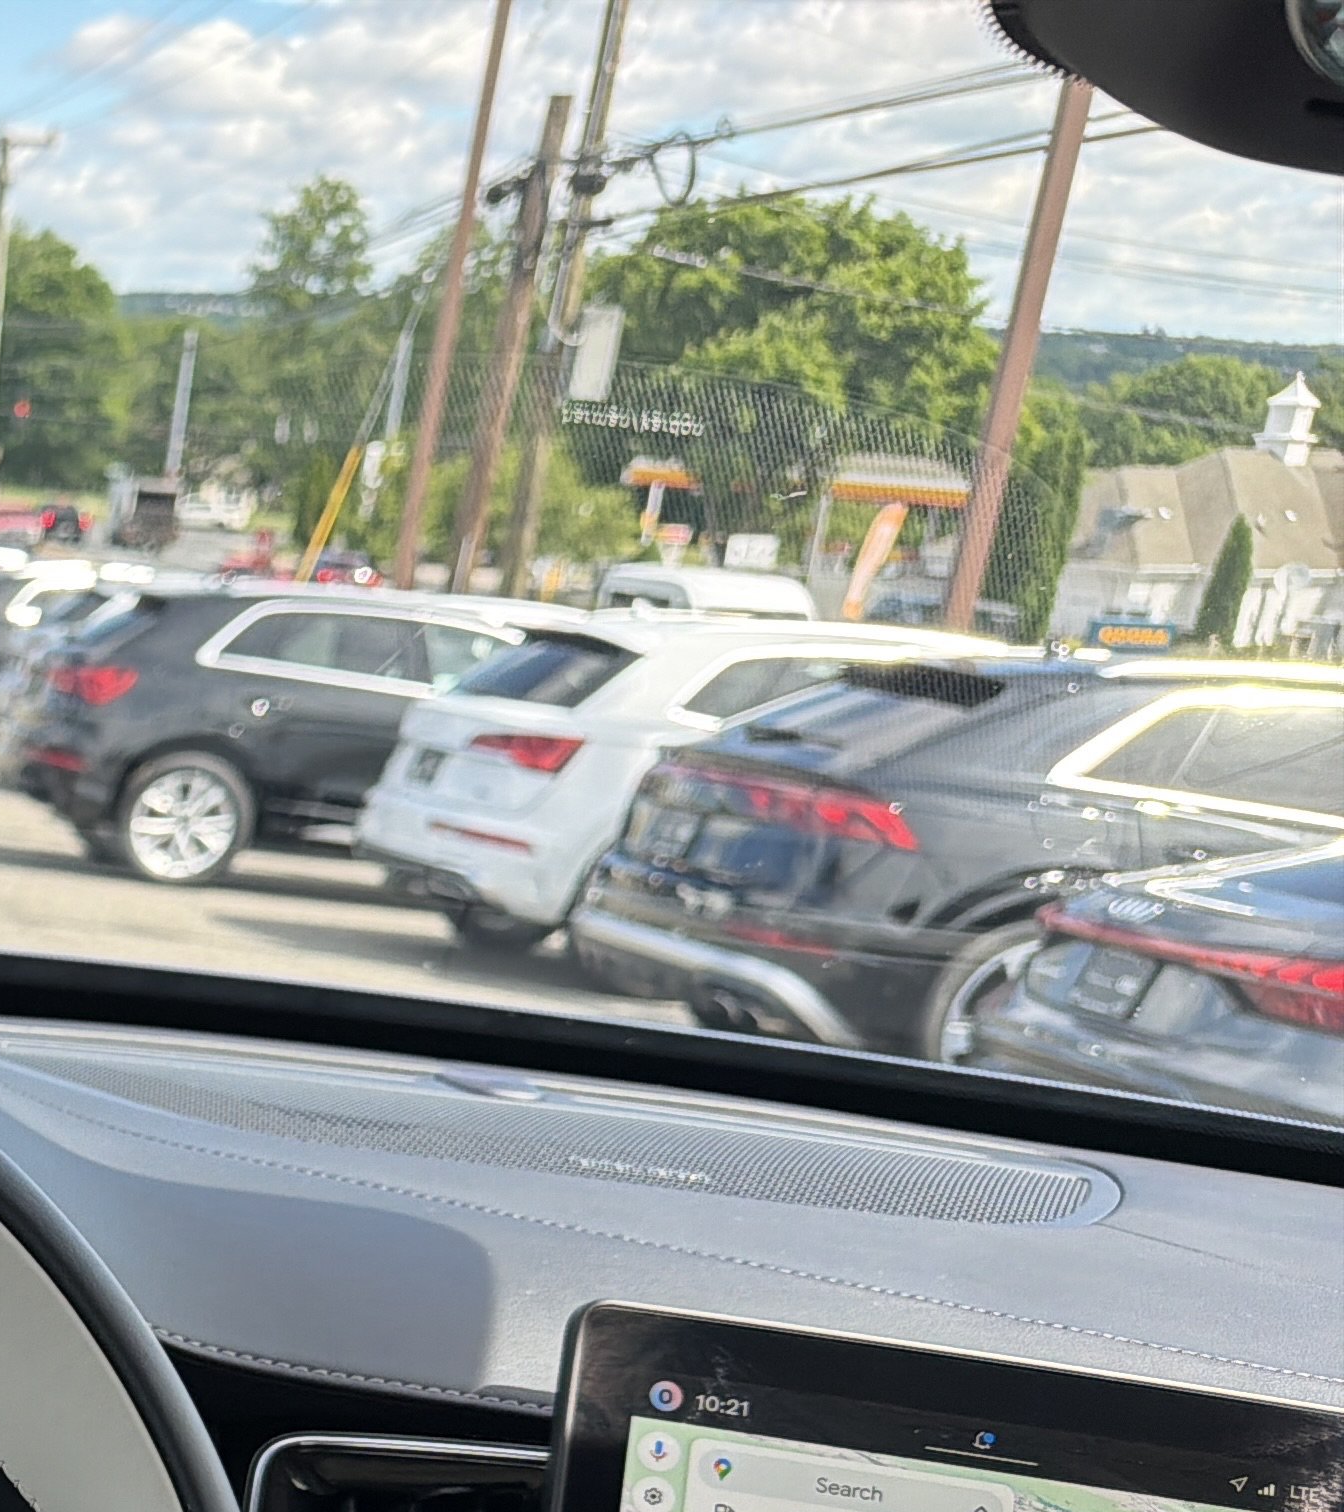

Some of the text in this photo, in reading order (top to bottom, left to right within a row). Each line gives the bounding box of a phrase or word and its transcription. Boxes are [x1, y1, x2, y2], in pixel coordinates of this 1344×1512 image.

[695, 1393, 750, 1417] 10:21
[815, 1476, 883, 1503] Search
[1289, 1484, 1319, 1502] LTE
